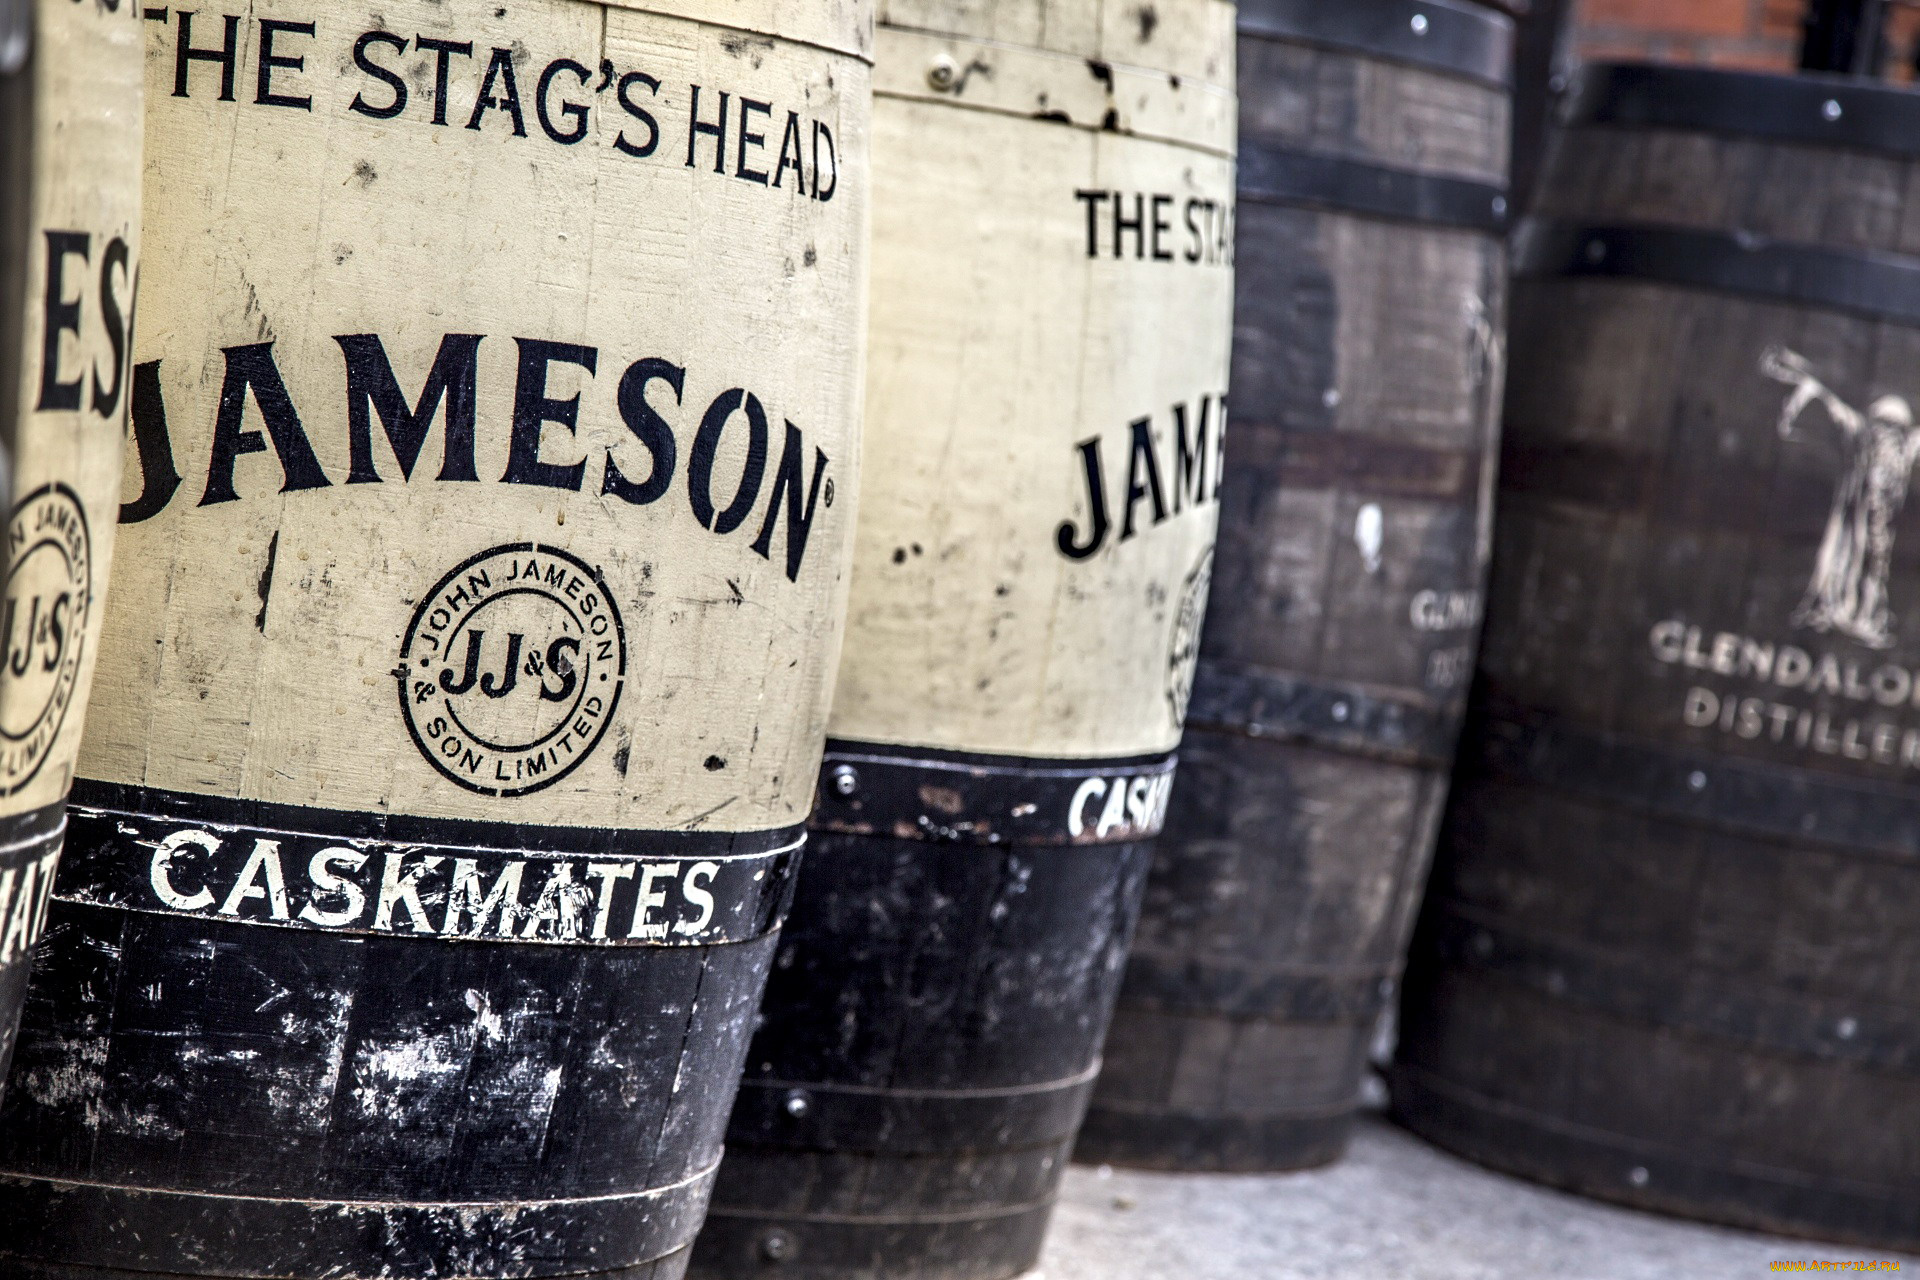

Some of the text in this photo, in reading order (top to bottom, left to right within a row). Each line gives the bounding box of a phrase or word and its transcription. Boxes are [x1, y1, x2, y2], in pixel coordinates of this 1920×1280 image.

[144, 6, 837, 202] HE STAG'S HEAD
[1074, 189, 1174, 262] THE
[420, 559, 614, 662] JOHN JAMESON
[438, 629, 582, 703] JJ&S
[1649, 618, 1920, 714] GLENDALO
[413, 680, 603, 781] & SON LIMITED
[151, 829, 723, 940] CASKMATES
